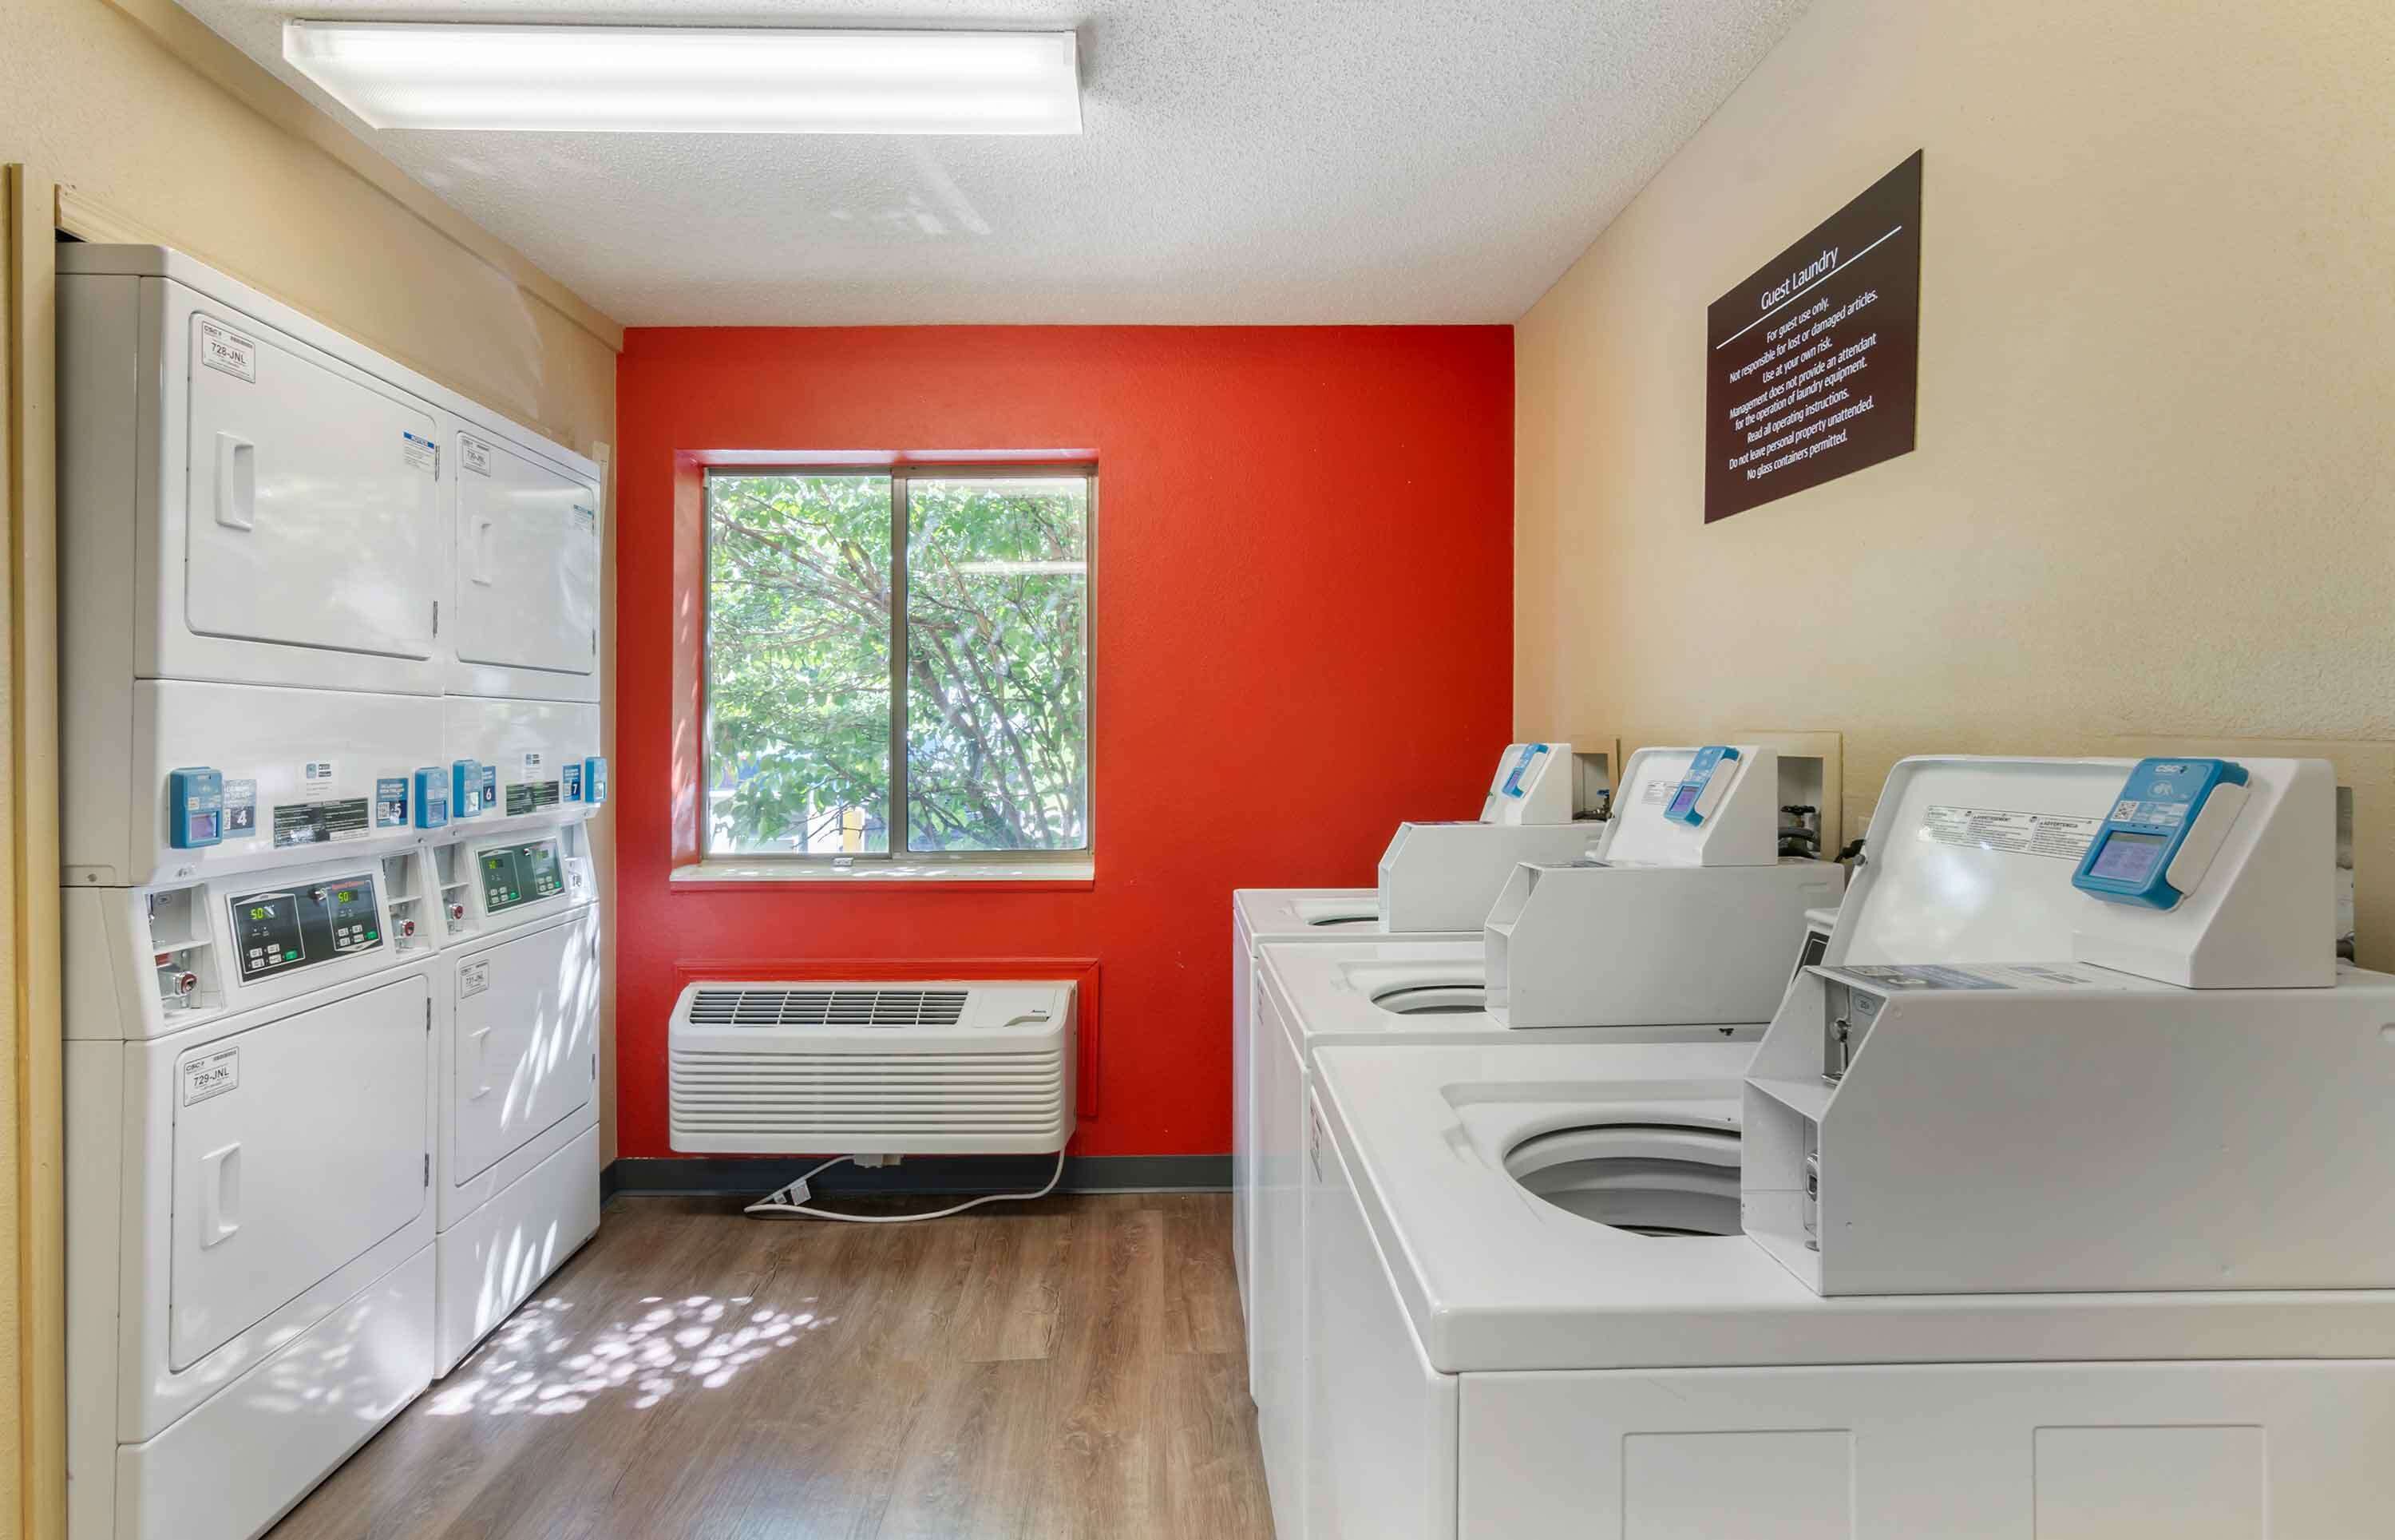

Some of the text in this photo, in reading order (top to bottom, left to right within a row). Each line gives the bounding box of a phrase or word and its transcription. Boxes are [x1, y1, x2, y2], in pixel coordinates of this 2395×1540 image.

[1761, 247, 1839, 310] Guest Laundry
[1730, 290, 1878, 383] Not responsible for lost or damaged articles.
[1767, 297, 1829, 343] For guest use only.
[211, 342, 247, 365] 728-JNL
[1729, 332, 1877, 419] Management does not provide an attendant
[1763, 335, 1833, 383] Use at your own risk.
[1735, 356, 1867, 431] for the operation of laundry equipment.
[1747, 428, 1763, 444] Read
[1772, 410, 1804, 433] operating
[1805, 387, 1850, 418] instructions.
[1728, 395, 1874, 470] Do not leave personal property unattended.
[1747, 429, 1847, 481] No glass containers permitted.
[237, 810, 247, 826] 4
[485, 787, 492, 801] 6
[193, 1066, 229, 1086] 729-JNL
